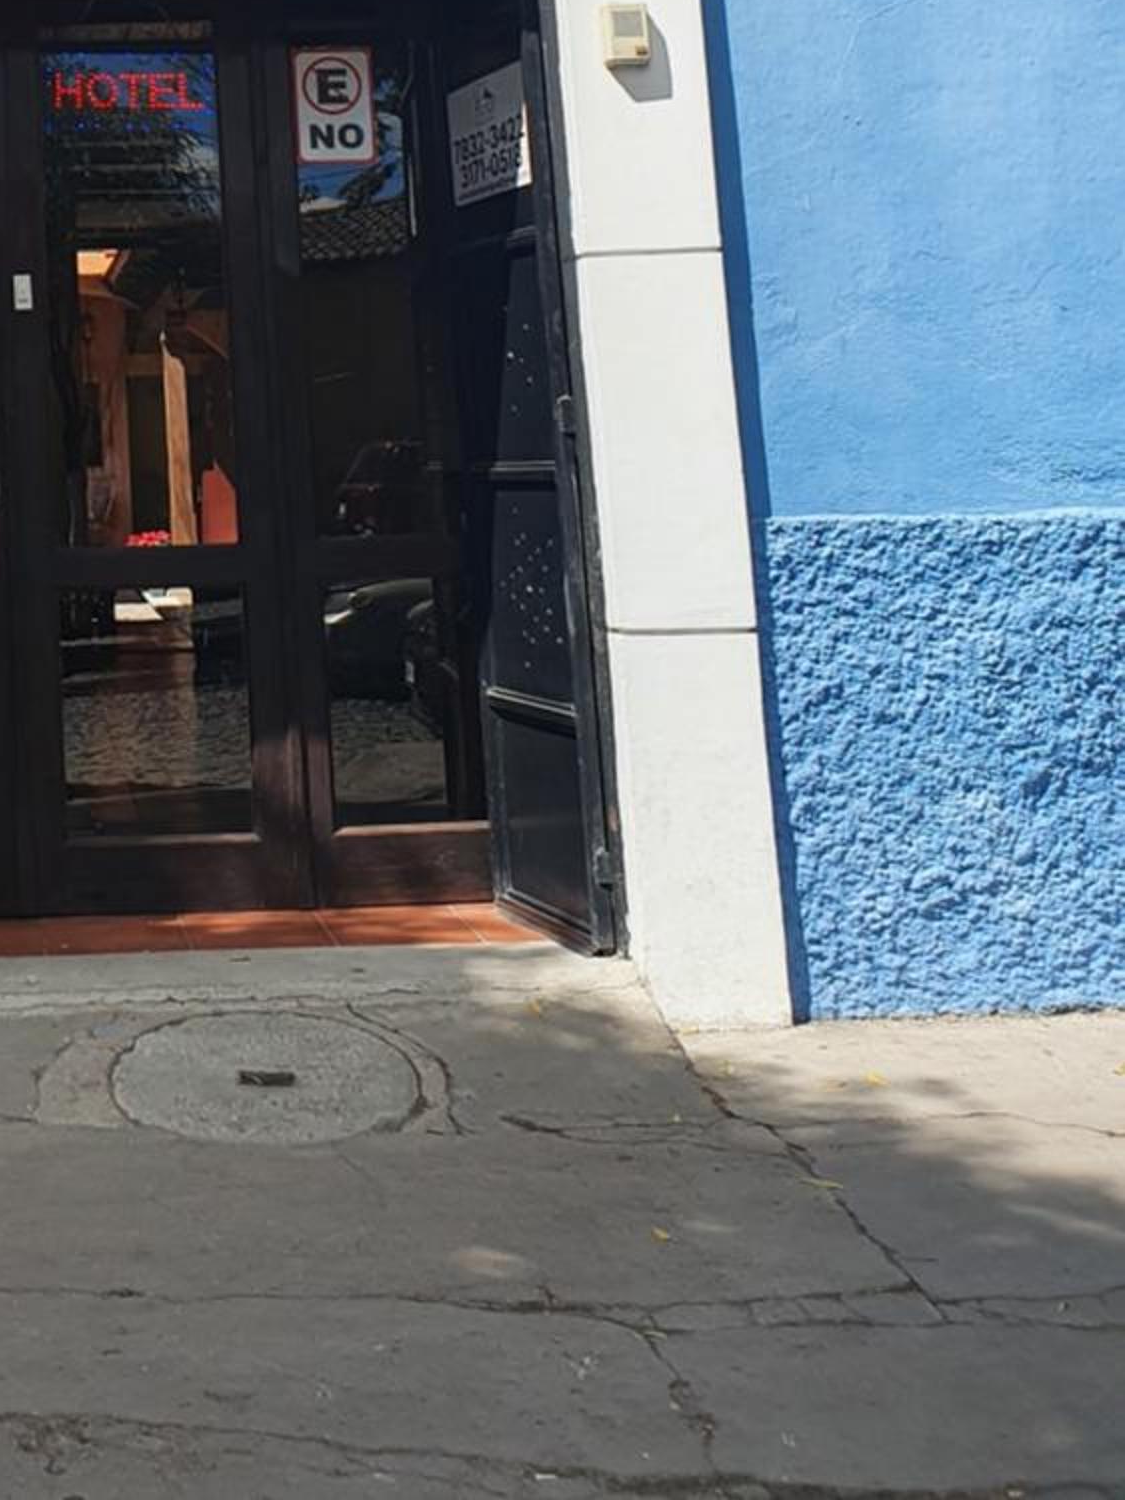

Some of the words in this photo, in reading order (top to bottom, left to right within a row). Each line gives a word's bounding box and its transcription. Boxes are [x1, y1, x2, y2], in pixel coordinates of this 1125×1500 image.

[52, 69, 206, 112] HOTEL
[315, 68, 350, 104] E
[309, 123, 364, 149] NO
[454, 113, 523, 164] 7832-3422
